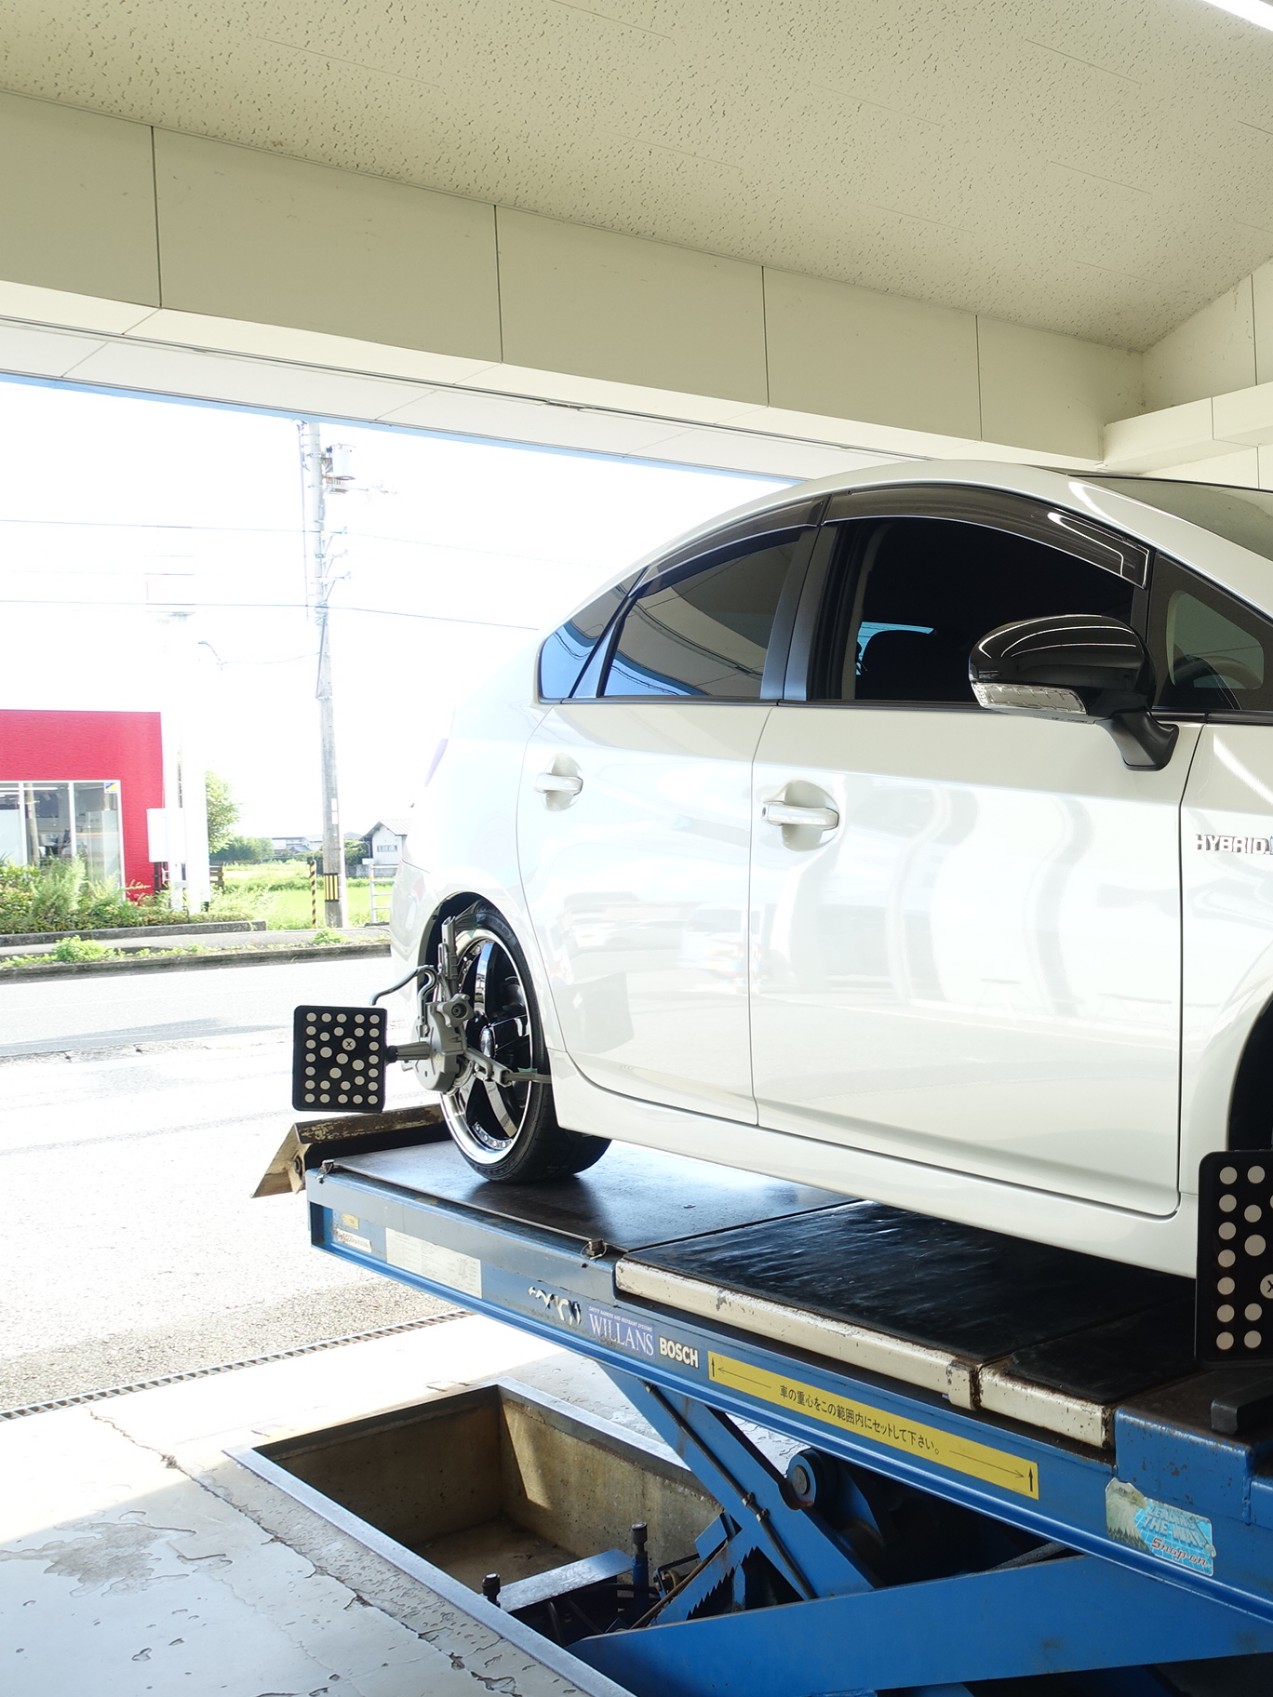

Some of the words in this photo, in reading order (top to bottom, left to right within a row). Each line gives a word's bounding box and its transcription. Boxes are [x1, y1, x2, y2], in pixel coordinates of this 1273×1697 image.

[1196, 834, 1267, 855] HYBRID
[589, 1313, 654, 1357] WILLANS
[659, 1336, 699, 1369] BOSCH
[780, 1385, 940, 1455] 車の重心をこの範囲内にセットして下さい。
[1142, 1515, 1169, 1535] THE
